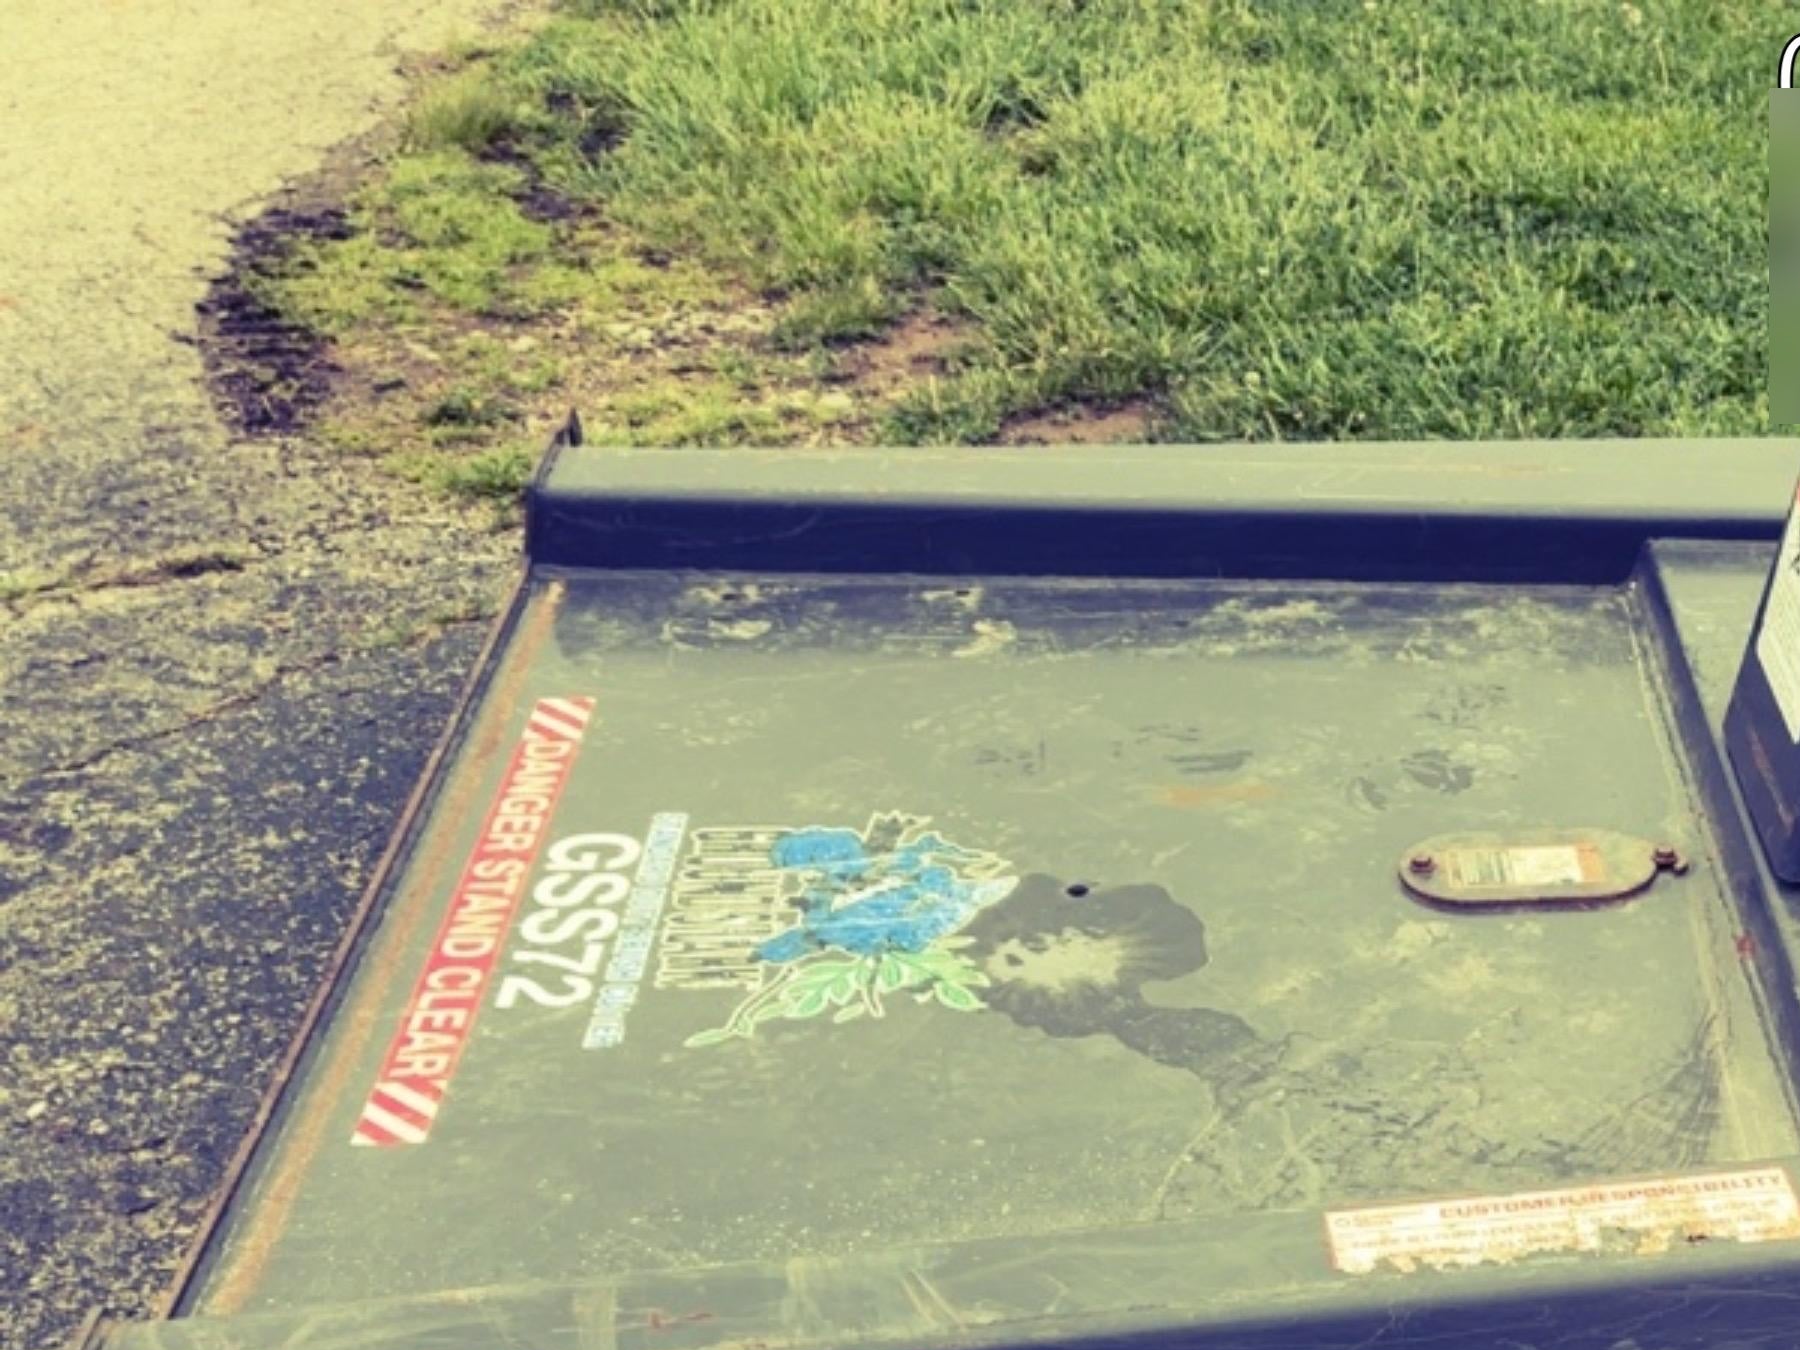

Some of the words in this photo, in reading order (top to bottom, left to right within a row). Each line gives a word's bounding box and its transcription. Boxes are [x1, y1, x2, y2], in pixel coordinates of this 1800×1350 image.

[482, 740, 573, 853] DANGER
[439, 859, 528, 960] STAND
[494, 833, 642, 1010] GSS72
[388, 965, 482, 1078] CLEAR
[1438, 1194, 1575, 1219] CUSTOMER
